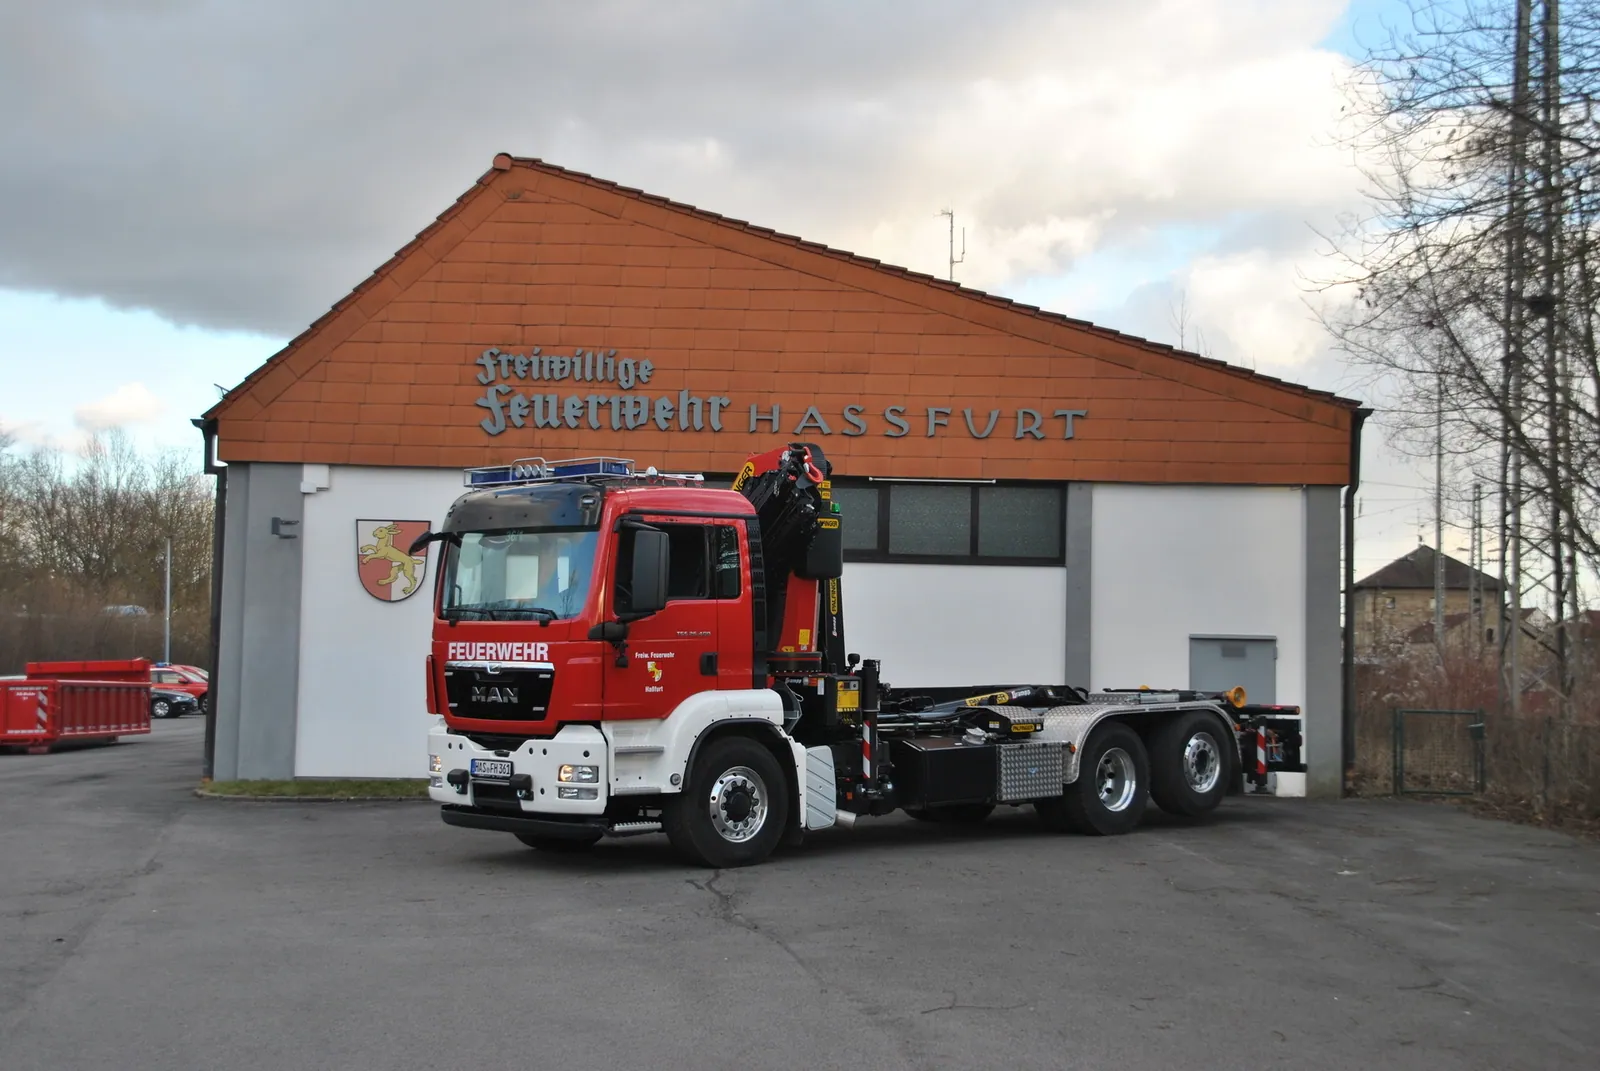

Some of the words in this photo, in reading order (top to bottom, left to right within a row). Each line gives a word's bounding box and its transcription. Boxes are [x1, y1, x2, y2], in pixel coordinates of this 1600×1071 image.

[476, 347, 654, 390] Freiwillige
[475, 384, 731, 436] Feuerwehr
[749, 403, 1088, 440] HASSFURT
[448, 642, 549, 661] FEUERWEHR
[650, 651, 675, 659] Feuerwehr
[471, 686, 519, 704] MAN
